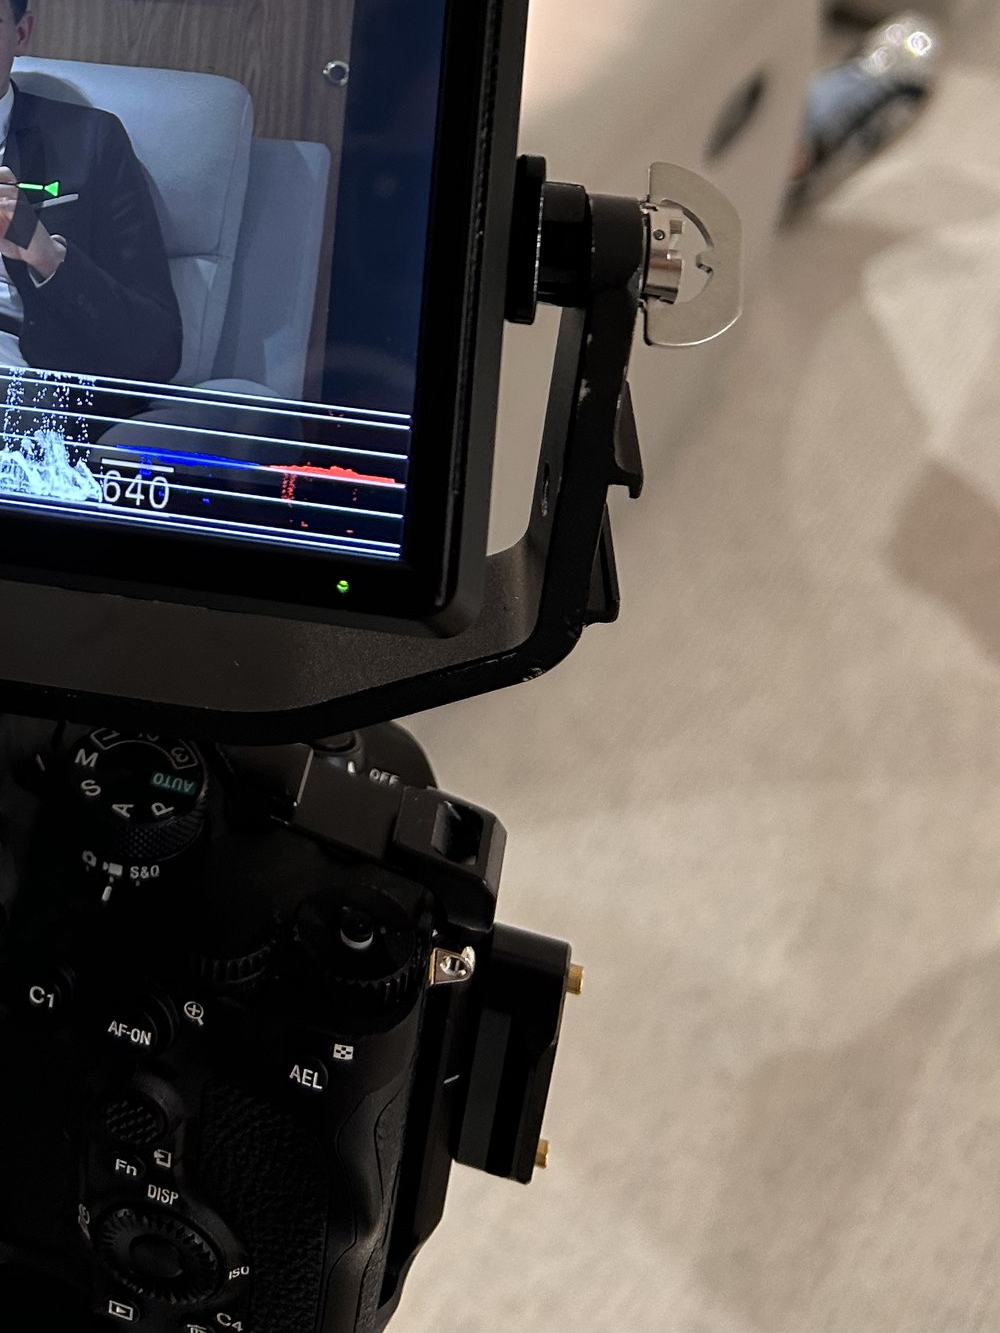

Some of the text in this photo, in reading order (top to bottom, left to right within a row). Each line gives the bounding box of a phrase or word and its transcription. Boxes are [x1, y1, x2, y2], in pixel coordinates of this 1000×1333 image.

[102, 468, 171, 510] 640
[74, 748, 99, 768] M
[152, 771, 195, 794] AUTO
[370, 767, 399, 786] OFF
[80, 779, 102, 797] S
[111, 803, 134, 818] A
[150, 802, 175, 817] P
[29, 985, 56, 1008] C1
[107, 1019, 152, 1047] AF-ON
[289, 1064, 323, 1090] AEL
[115, 1157, 138, 1177] Fn
[147, 1183, 179, 1206] DISP
